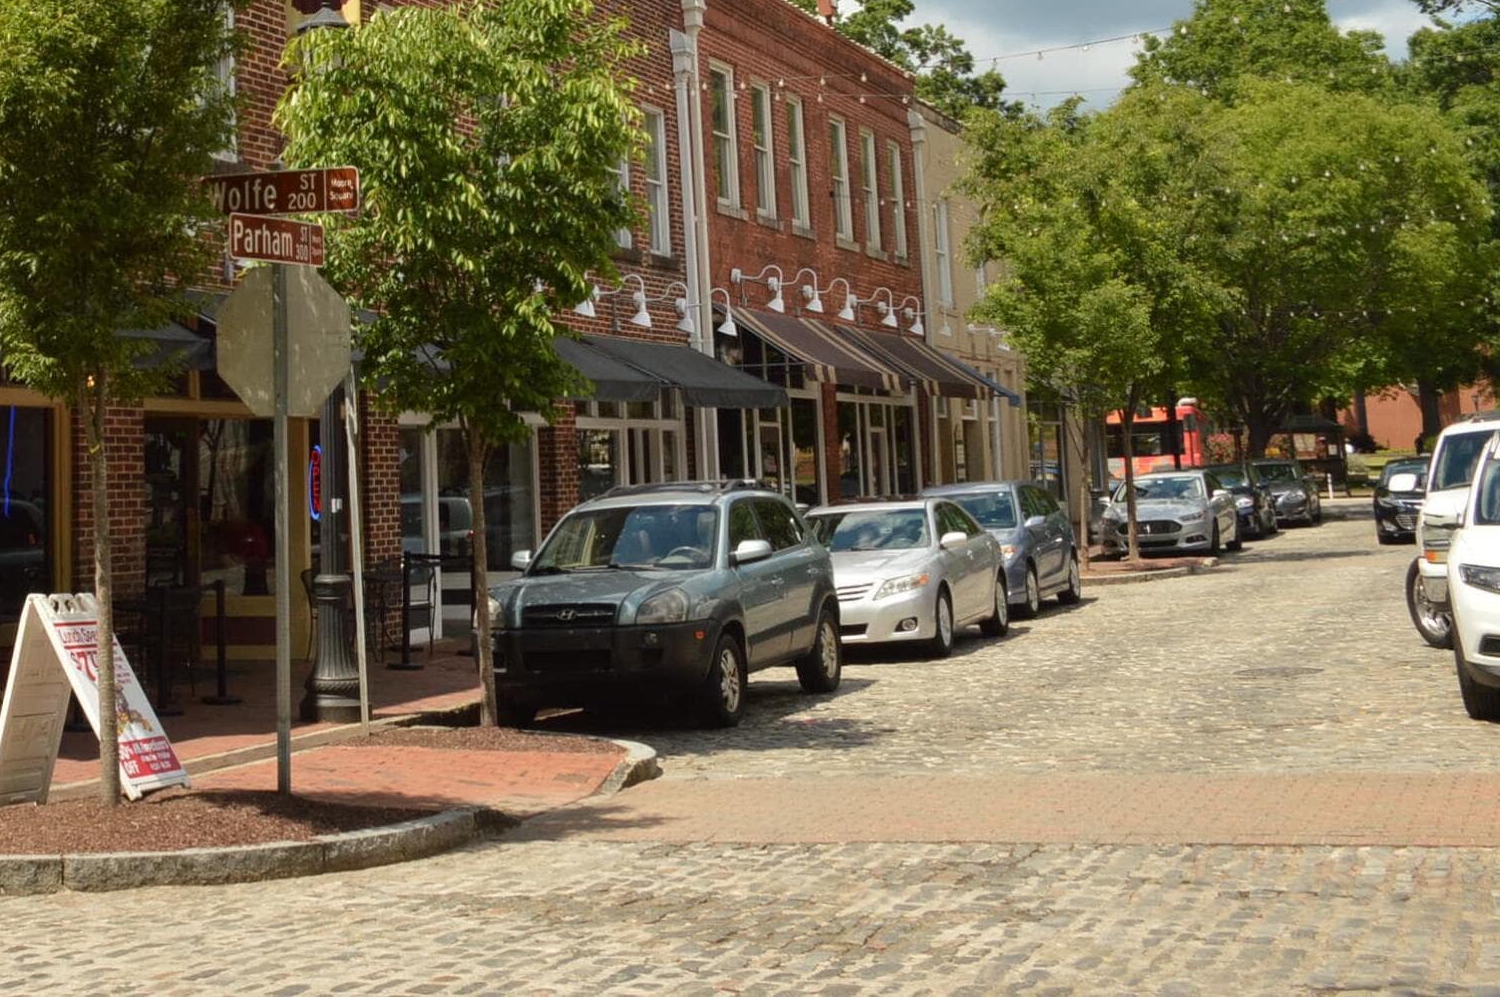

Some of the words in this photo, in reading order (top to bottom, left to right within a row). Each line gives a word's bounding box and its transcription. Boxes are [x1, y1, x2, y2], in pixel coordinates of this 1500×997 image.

[208, 179, 277, 213] Wolfe
[300, 173, 317, 190] ST
[288, 192, 316, 210] 200
[233, 219, 293, 257] Parham
[300, 225, 308, 243] ST
[295, 242, 309, 261] 300
